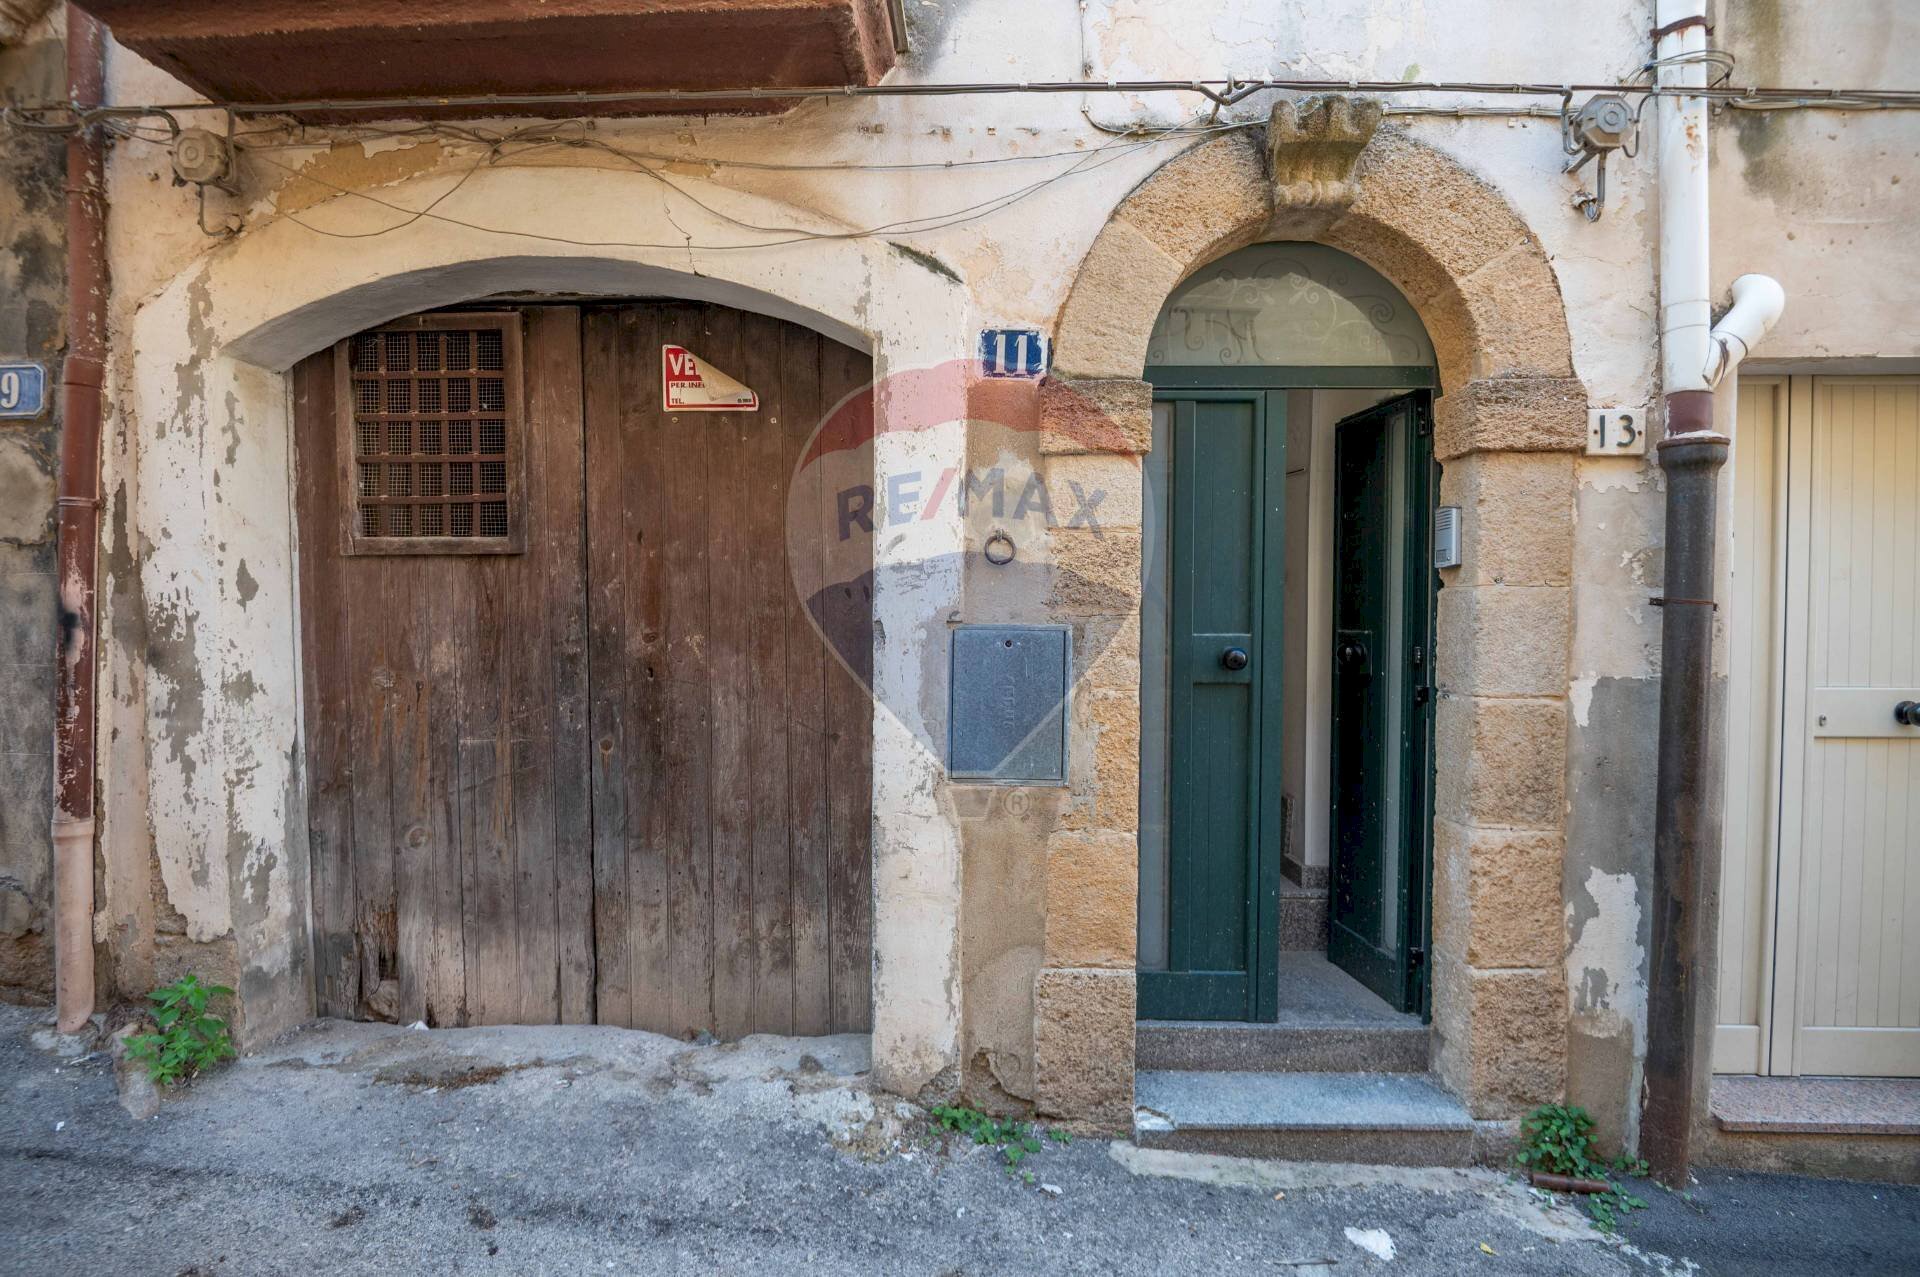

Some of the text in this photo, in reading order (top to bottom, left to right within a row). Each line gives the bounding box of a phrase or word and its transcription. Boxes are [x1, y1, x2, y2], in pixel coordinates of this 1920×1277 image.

[992, 334, 1027, 375] 11
[1, 372, 20, 409] 9
[1599, 414, 1636, 449] 13
